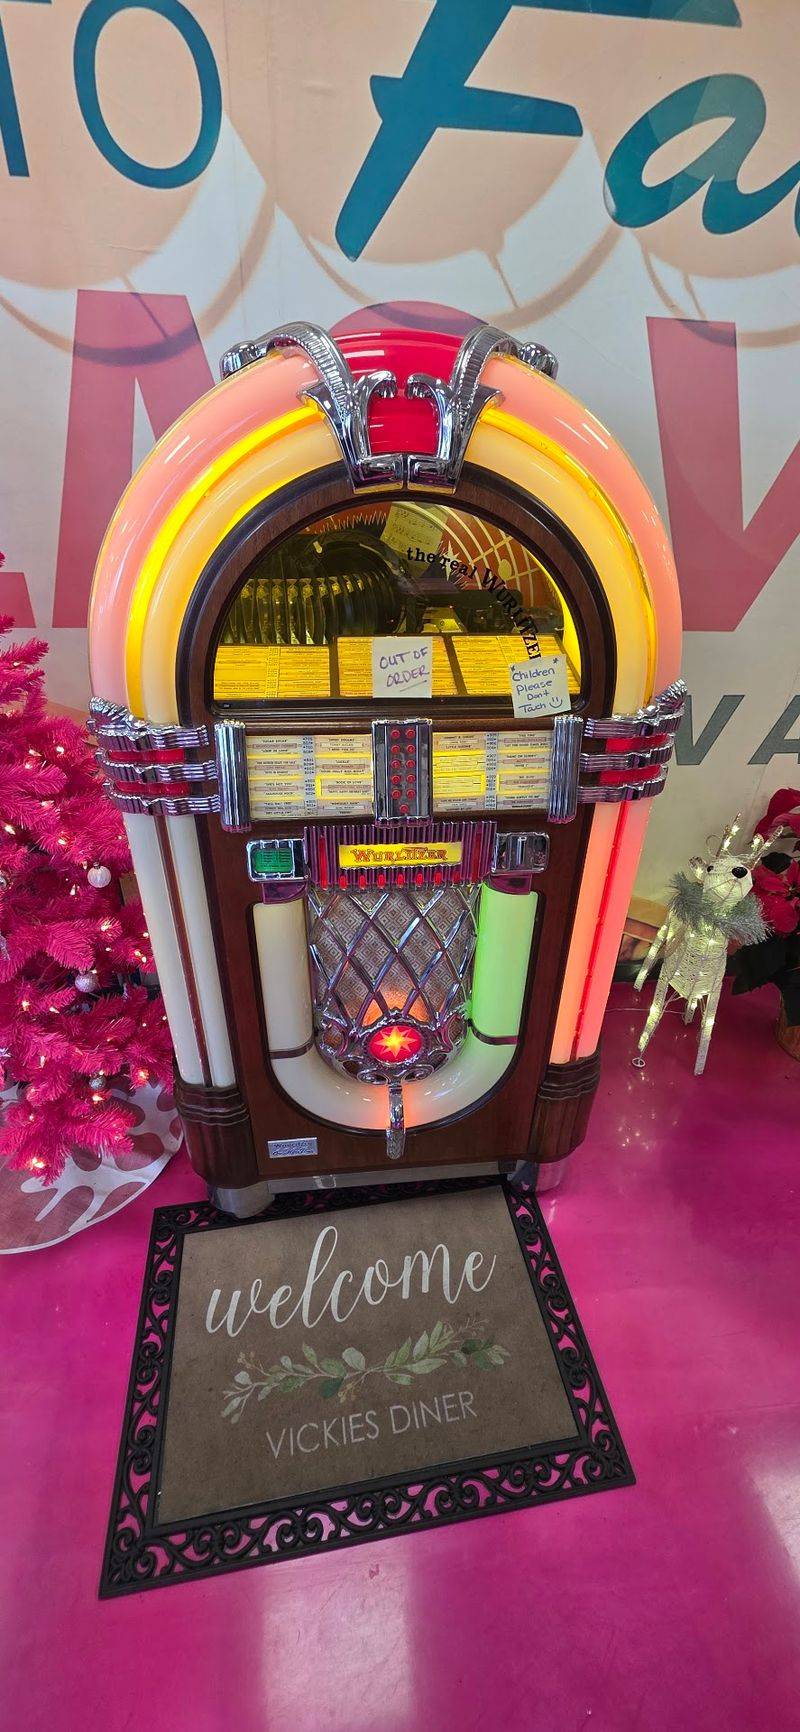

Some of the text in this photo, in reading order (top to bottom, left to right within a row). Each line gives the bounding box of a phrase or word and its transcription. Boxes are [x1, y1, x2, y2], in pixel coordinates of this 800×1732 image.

[407, 547, 541, 660] the real WURLITZE
[380, 647, 428, 669] OUT OF
[387, 665, 429, 687] ORDER
[512, 668, 555, 681] Children
[516, 681, 552, 695] Please
[350, 847, 448, 862] WURLITZER
[205, 1226, 496, 1337] welcome
[266, 1391, 477, 1459] VICKIES DINER
